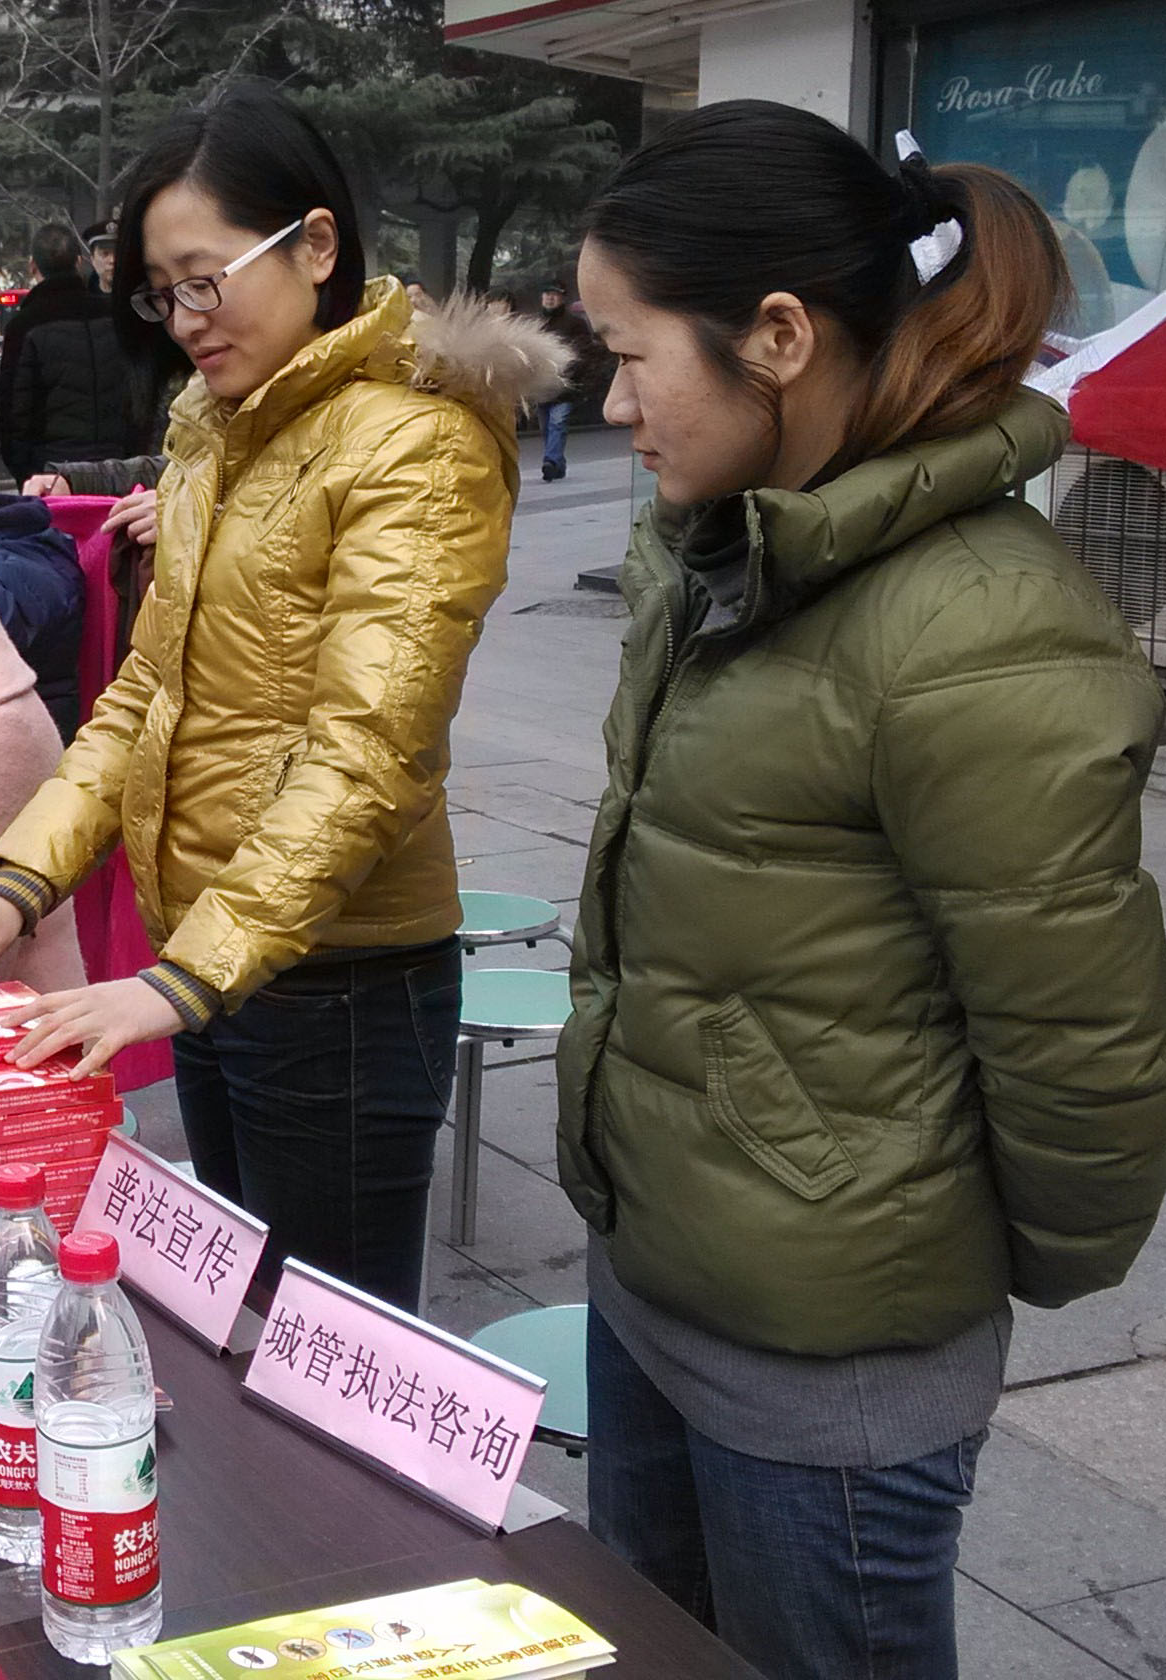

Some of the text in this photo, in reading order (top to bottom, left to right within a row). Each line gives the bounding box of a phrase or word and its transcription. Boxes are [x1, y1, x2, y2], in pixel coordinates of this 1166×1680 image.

[937, 59, 1103, 114] Rosa Cake
[103, 1161, 237, 1295] 普法宣传
[265, 1307, 521, 1481] 城管执法咨询
[114, 1545, 153, 1572] NONGFU
